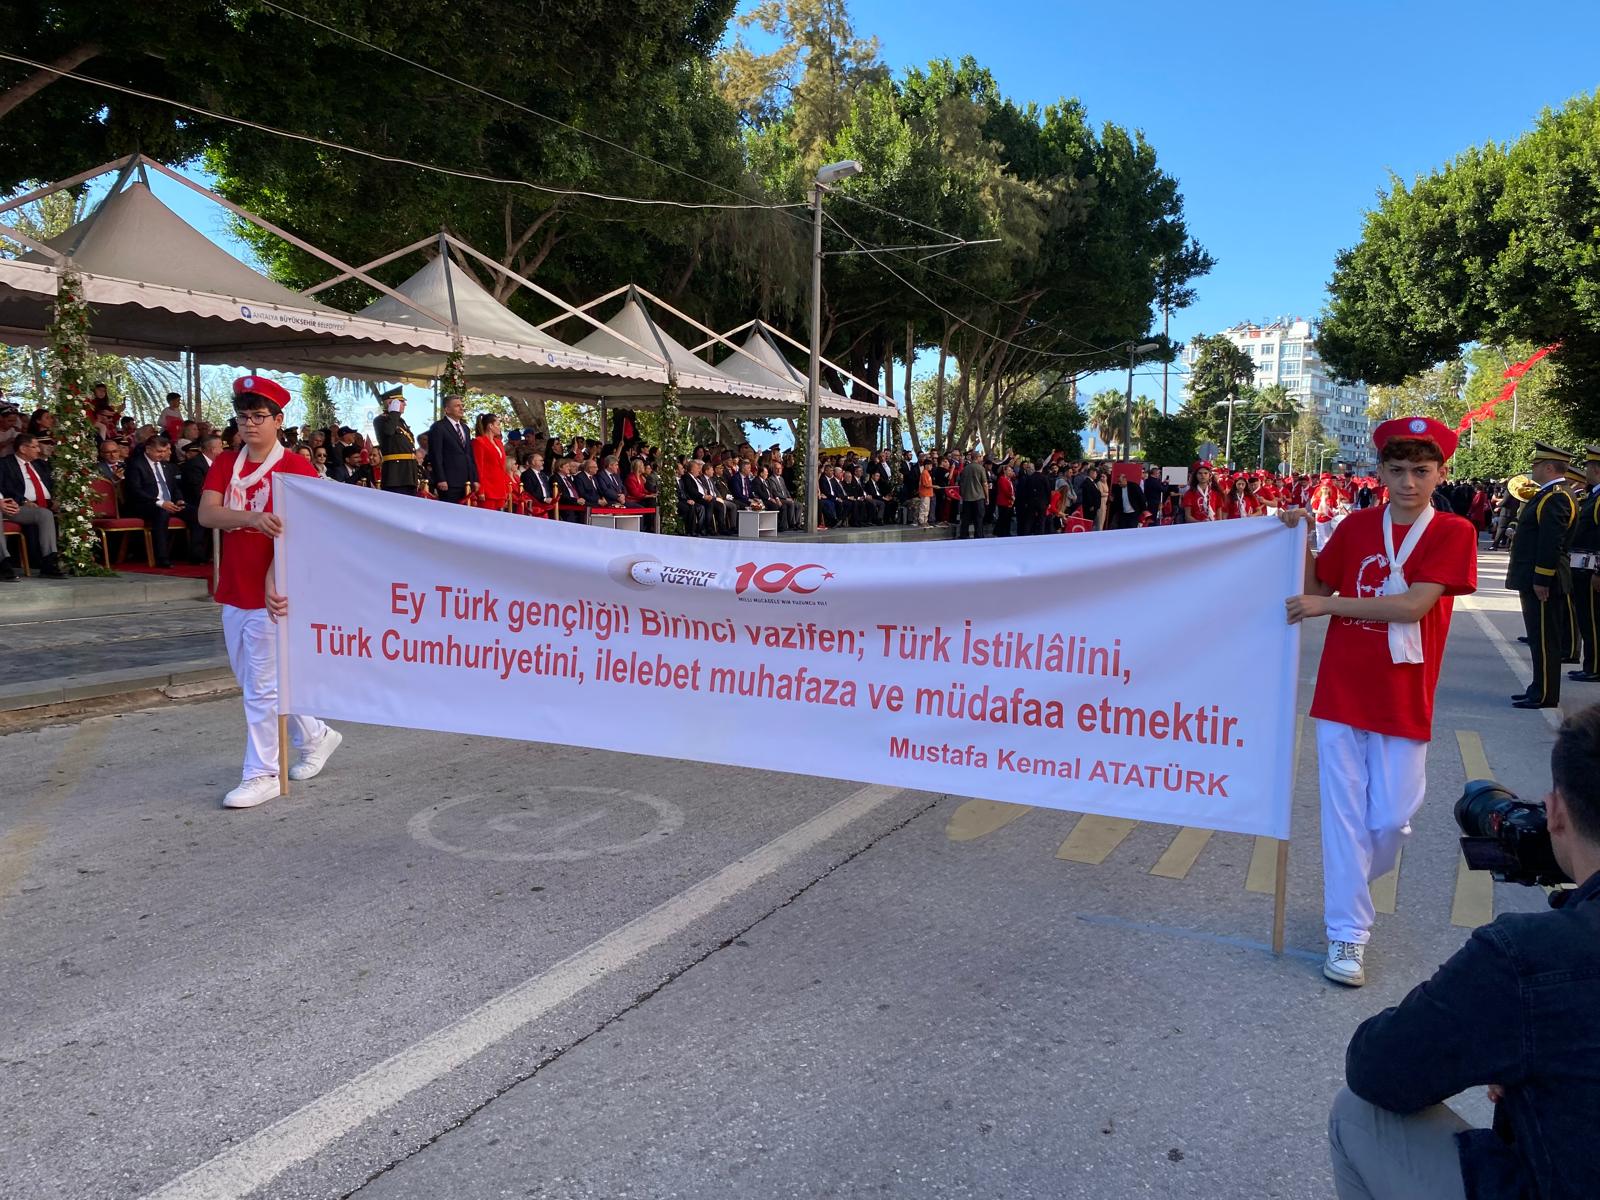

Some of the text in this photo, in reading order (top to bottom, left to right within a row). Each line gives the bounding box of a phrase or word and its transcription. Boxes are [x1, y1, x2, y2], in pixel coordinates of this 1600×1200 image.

[391, 582, 1132, 685] Ey Türk gençliği! Birinci vazifen; Türk İstiklâlini,
[310, 623, 1244, 748] Türk Cumhuriyetini, ilelebet muhafaza ve müdafaa etmektir.
[889, 736, 1231, 798] Mustafa Kemal ATATÜRK
